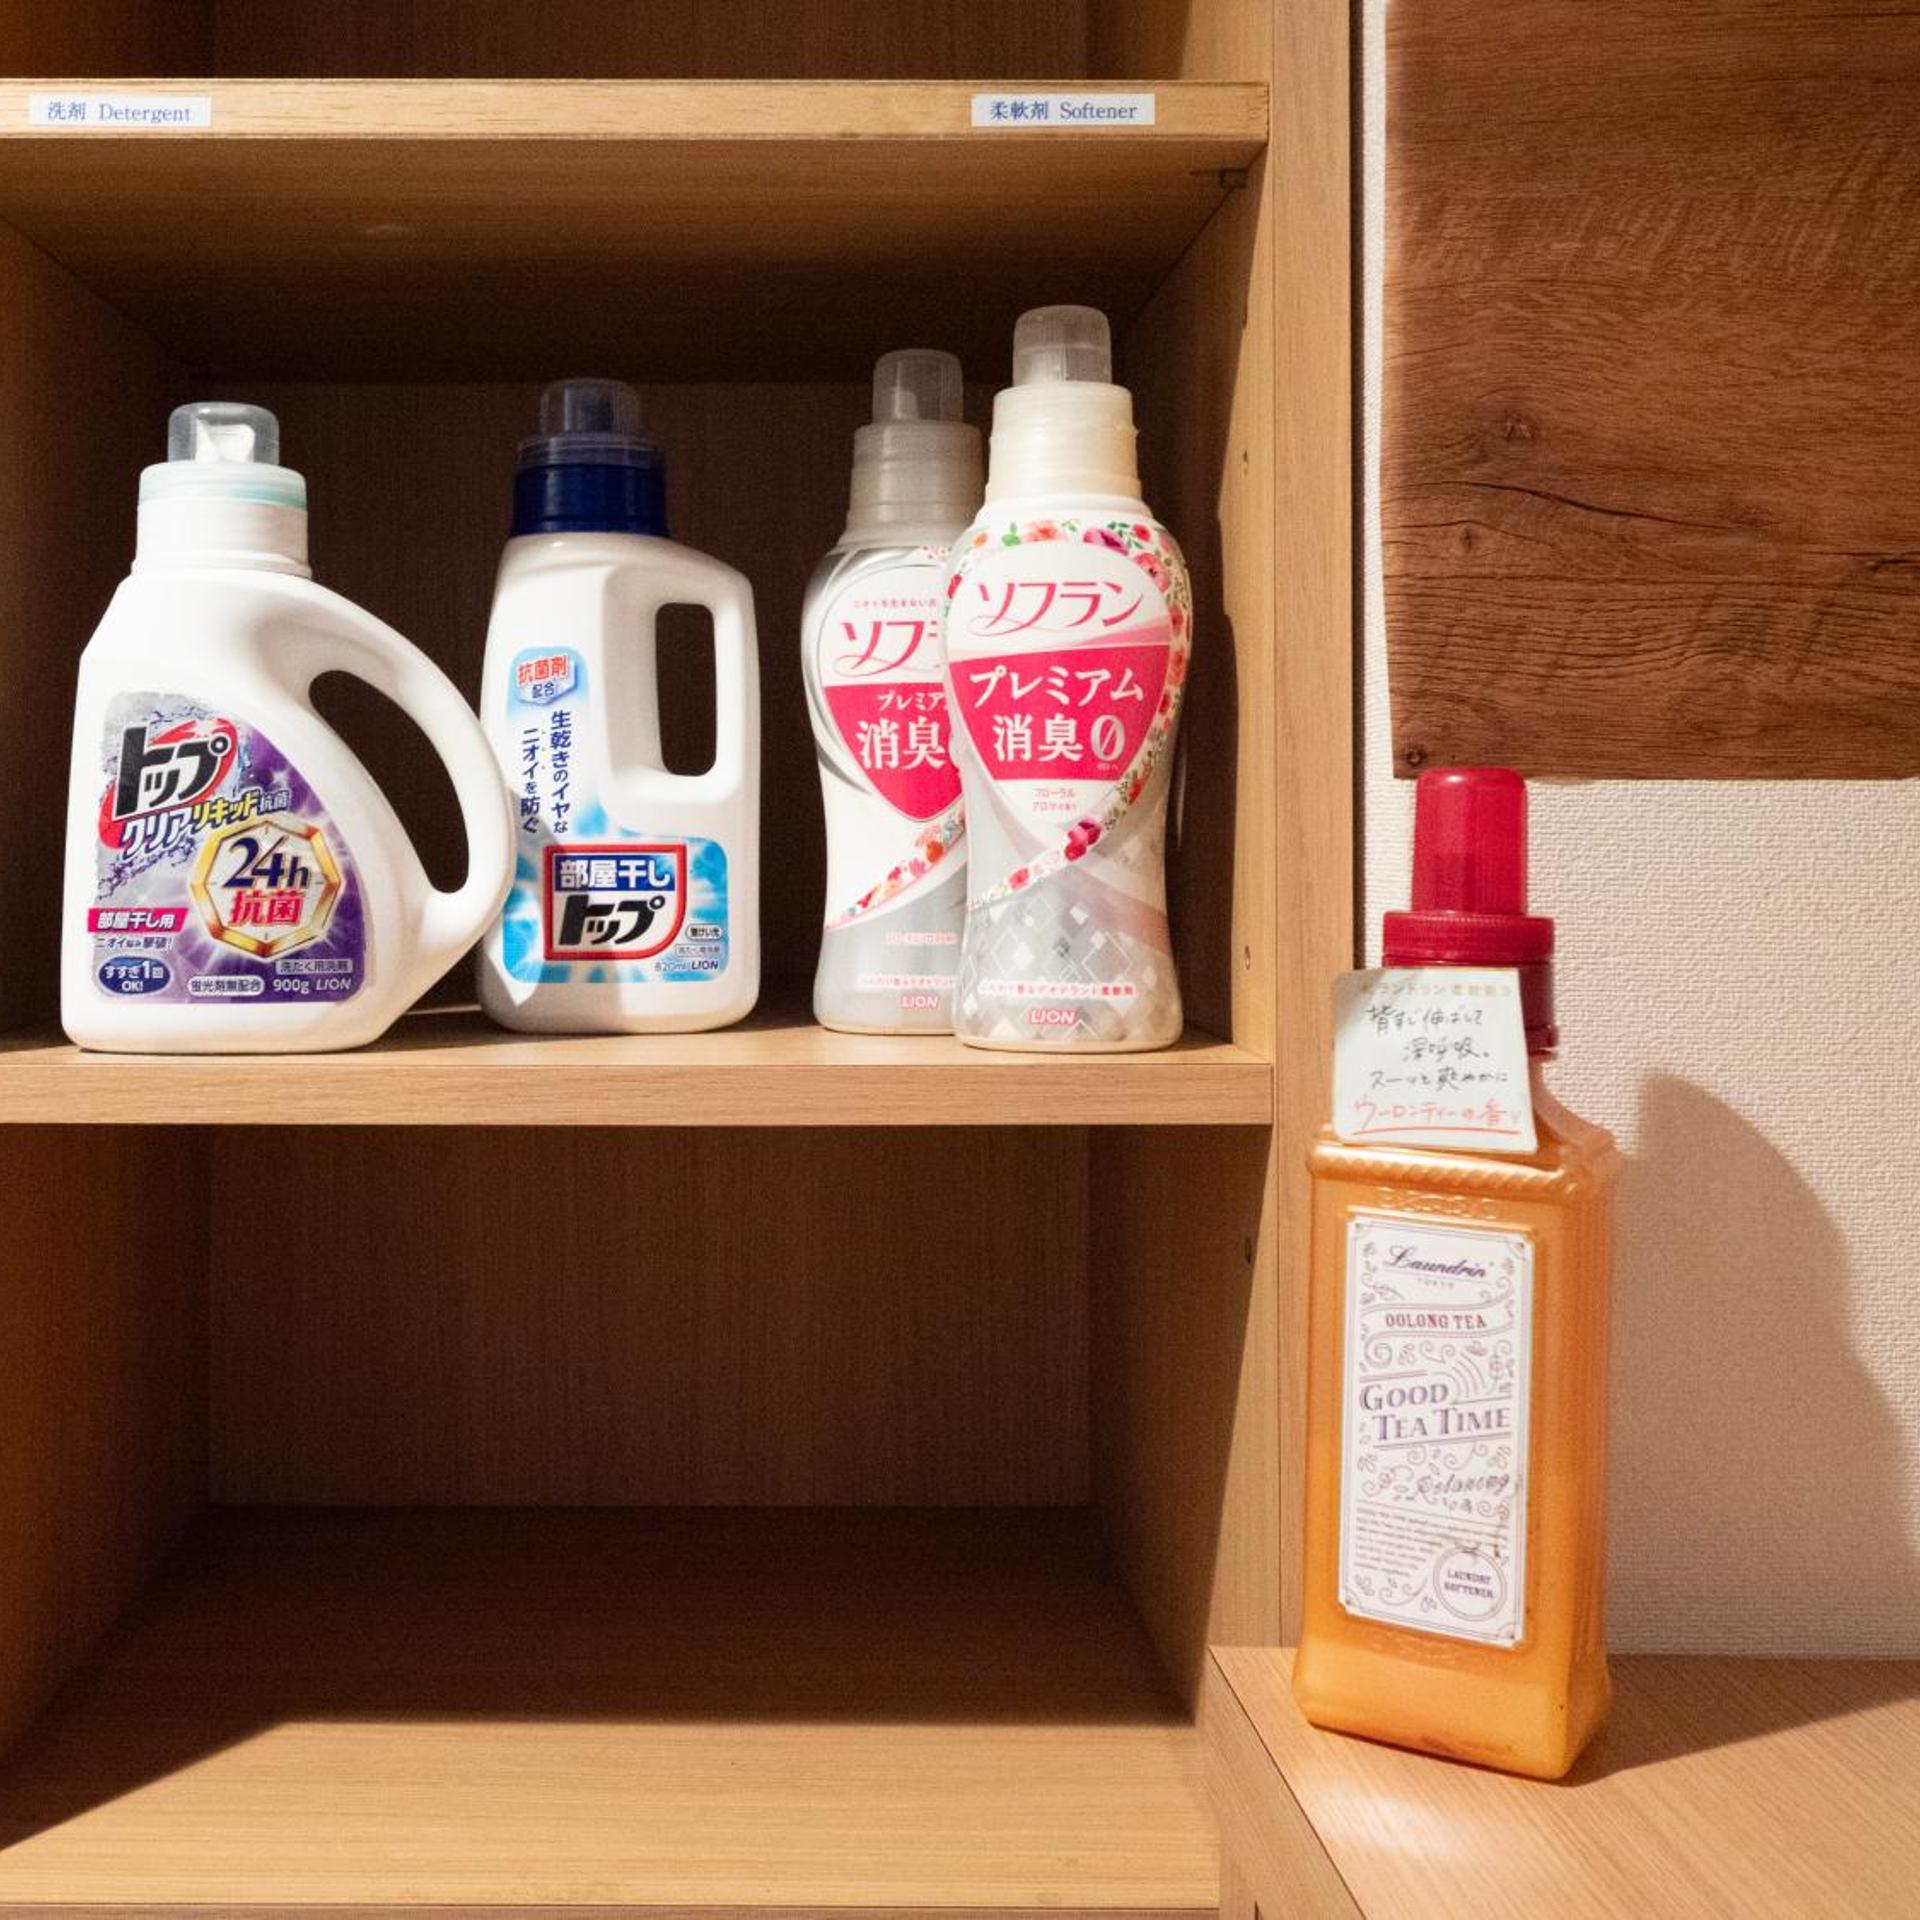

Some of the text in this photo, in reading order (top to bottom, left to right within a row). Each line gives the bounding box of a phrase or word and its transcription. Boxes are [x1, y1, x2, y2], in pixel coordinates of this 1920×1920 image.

[47, 101, 191, 123] 洗剤 Detergent
[990, 100, 1138, 120] 柔軟剤 Softener
[977, 580, 1143, 636] ソフラン
[518, 655, 568, 685] 抗菌剤
[532, 682, 555, 698] 配合
[969, 665, 1145, 708] プレミアム
[878, 690, 949, 712] プレミア
[856, 716, 956, 769] 消臭
[114, 725, 231, 818] トップ
[520, 728, 541, 834] ニオイを防ぐ
[550, 710, 572, 833] 生乾きのイヤな
[560, 859, 672, 890] 部屋干し
[97, 911, 176, 930] 部屋干し用
[227, 890, 305, 927] 抗菌
[558, 894, 667, 946] トップ
[691, 960, 720, 970] LION
[121, 980, 144, 993] OK!
[273, 978, 352, 994] 900g LION
[903, 996, 938, 1008] LION
[1030, 1010, 1076, 1025] LION
[1384, 1244, 1487, 1278] Laundrin
[1385, 1313, 1488, 1330] OOLONG TEA
[1360, 1383, 1449, 1411] GOOD
[1433, 1406, 1511, 1435] TIME
[1447, 1569, 1492, 1584] LAUNDRY
[1443, 1581, 1495, 1599] SOFTENER
